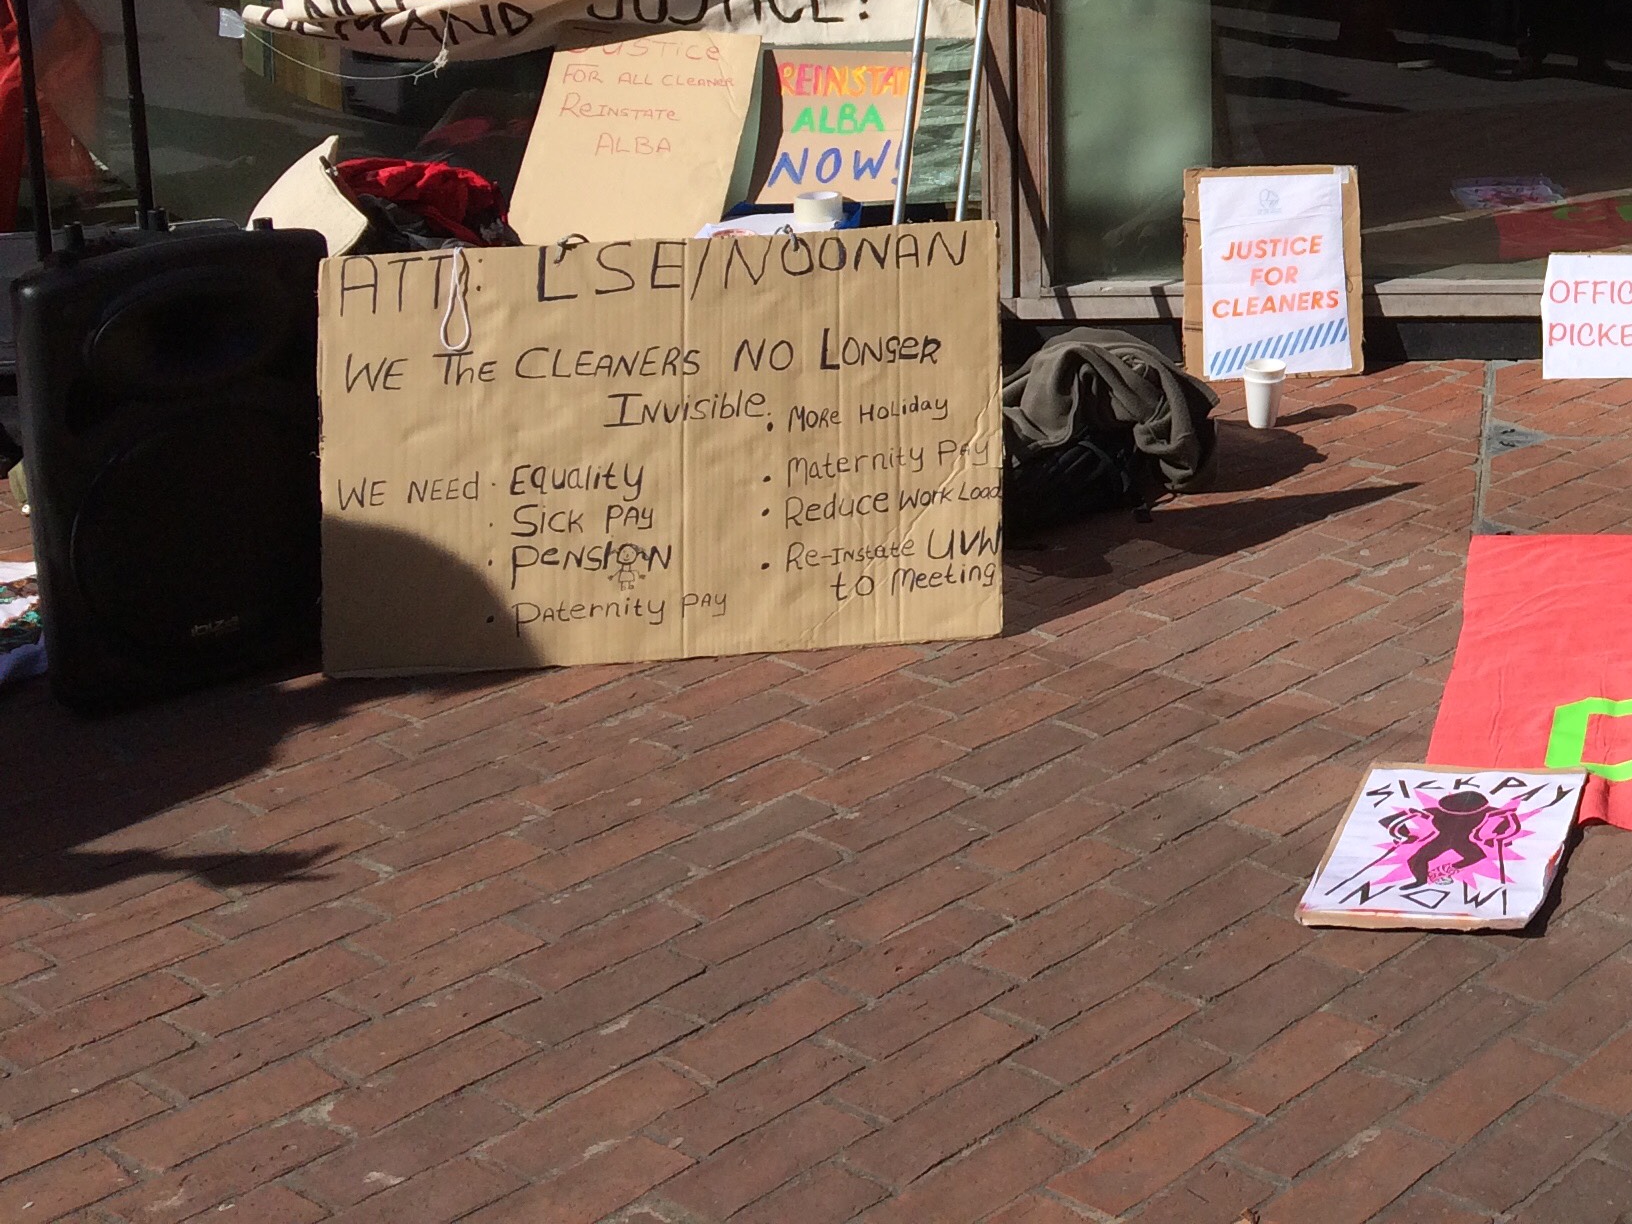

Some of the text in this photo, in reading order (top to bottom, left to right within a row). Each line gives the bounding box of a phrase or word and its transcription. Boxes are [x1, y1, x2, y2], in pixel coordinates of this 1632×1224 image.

[618, 71, 653, 86] ALL
[790, 103, 886, 136] ALBA
[596, 132, 672, 157] ALBA
[1221, 234, 1324, 262] JUSTICE
[1250, 265, 1299, 287] FOR
[1212, 289, 1340, 319] CLEANERS
[346, 353, 409, 394] WE
[515, 345, 701, 379] CLEANERS
[734, 337, 795, 372] NO
[337, 476, 388, 511] WE
[1366, 776, 1481, 808] SICK
